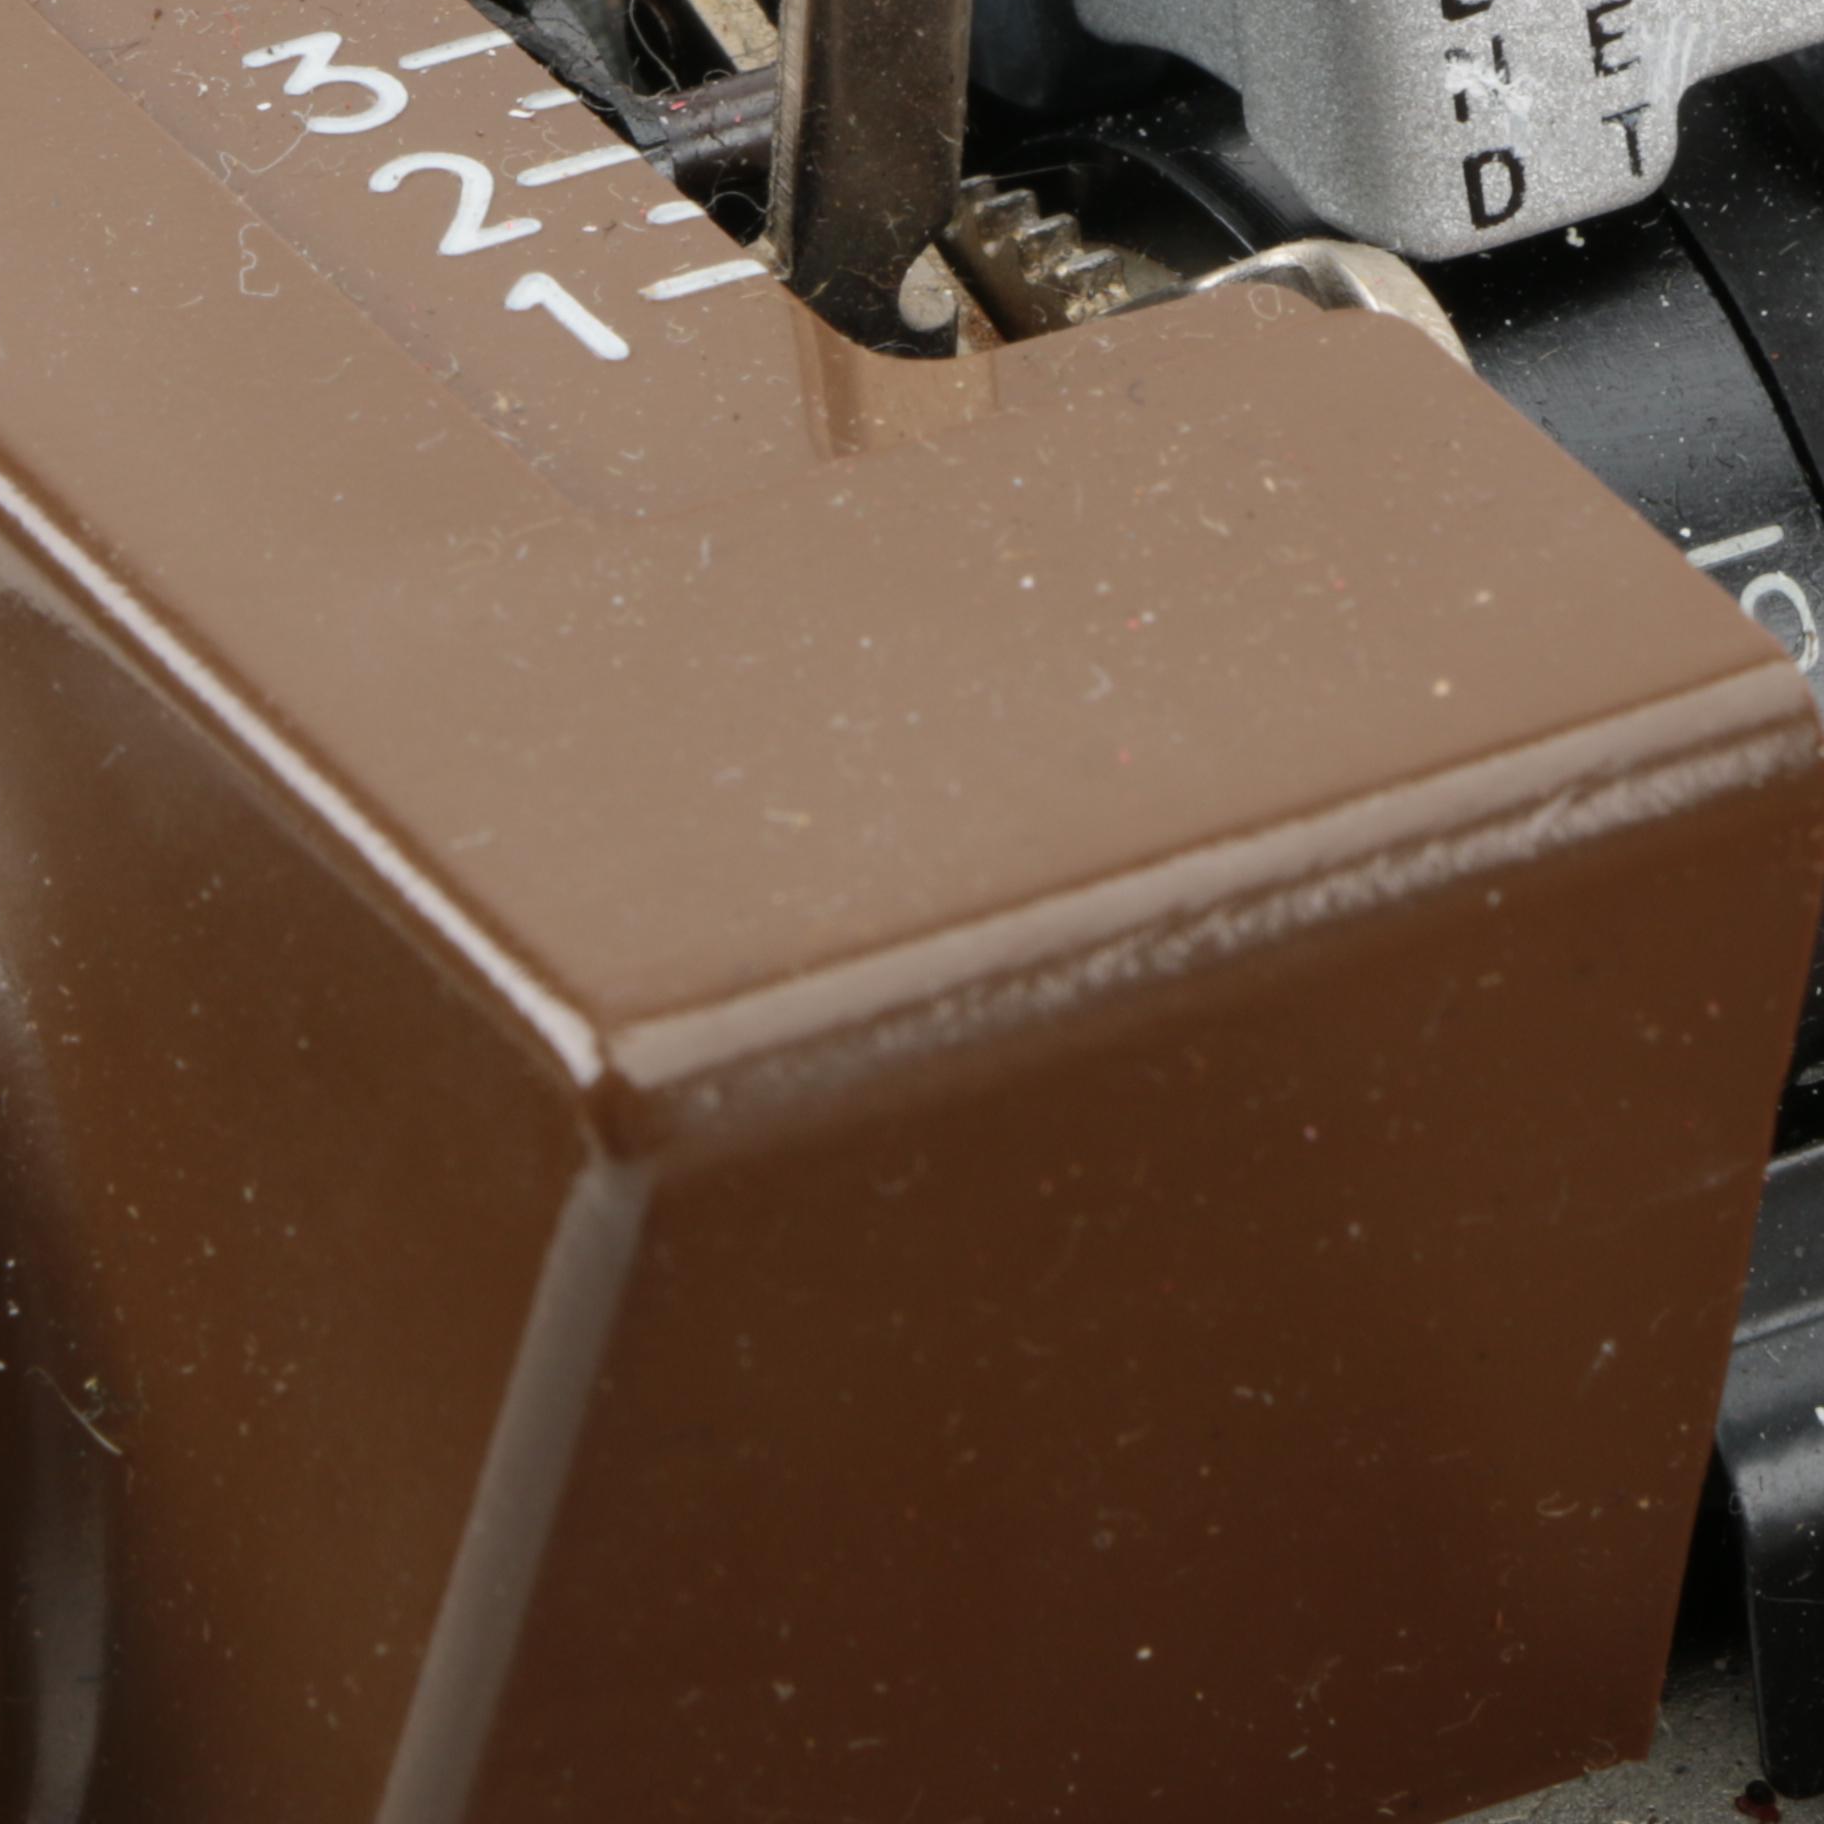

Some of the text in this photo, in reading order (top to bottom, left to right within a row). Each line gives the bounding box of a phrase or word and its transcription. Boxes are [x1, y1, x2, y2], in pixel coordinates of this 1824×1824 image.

[242, 31, 408, 133] 3
[369, 152, 542, 256] 2
[504, 272, 630, 361] 1
